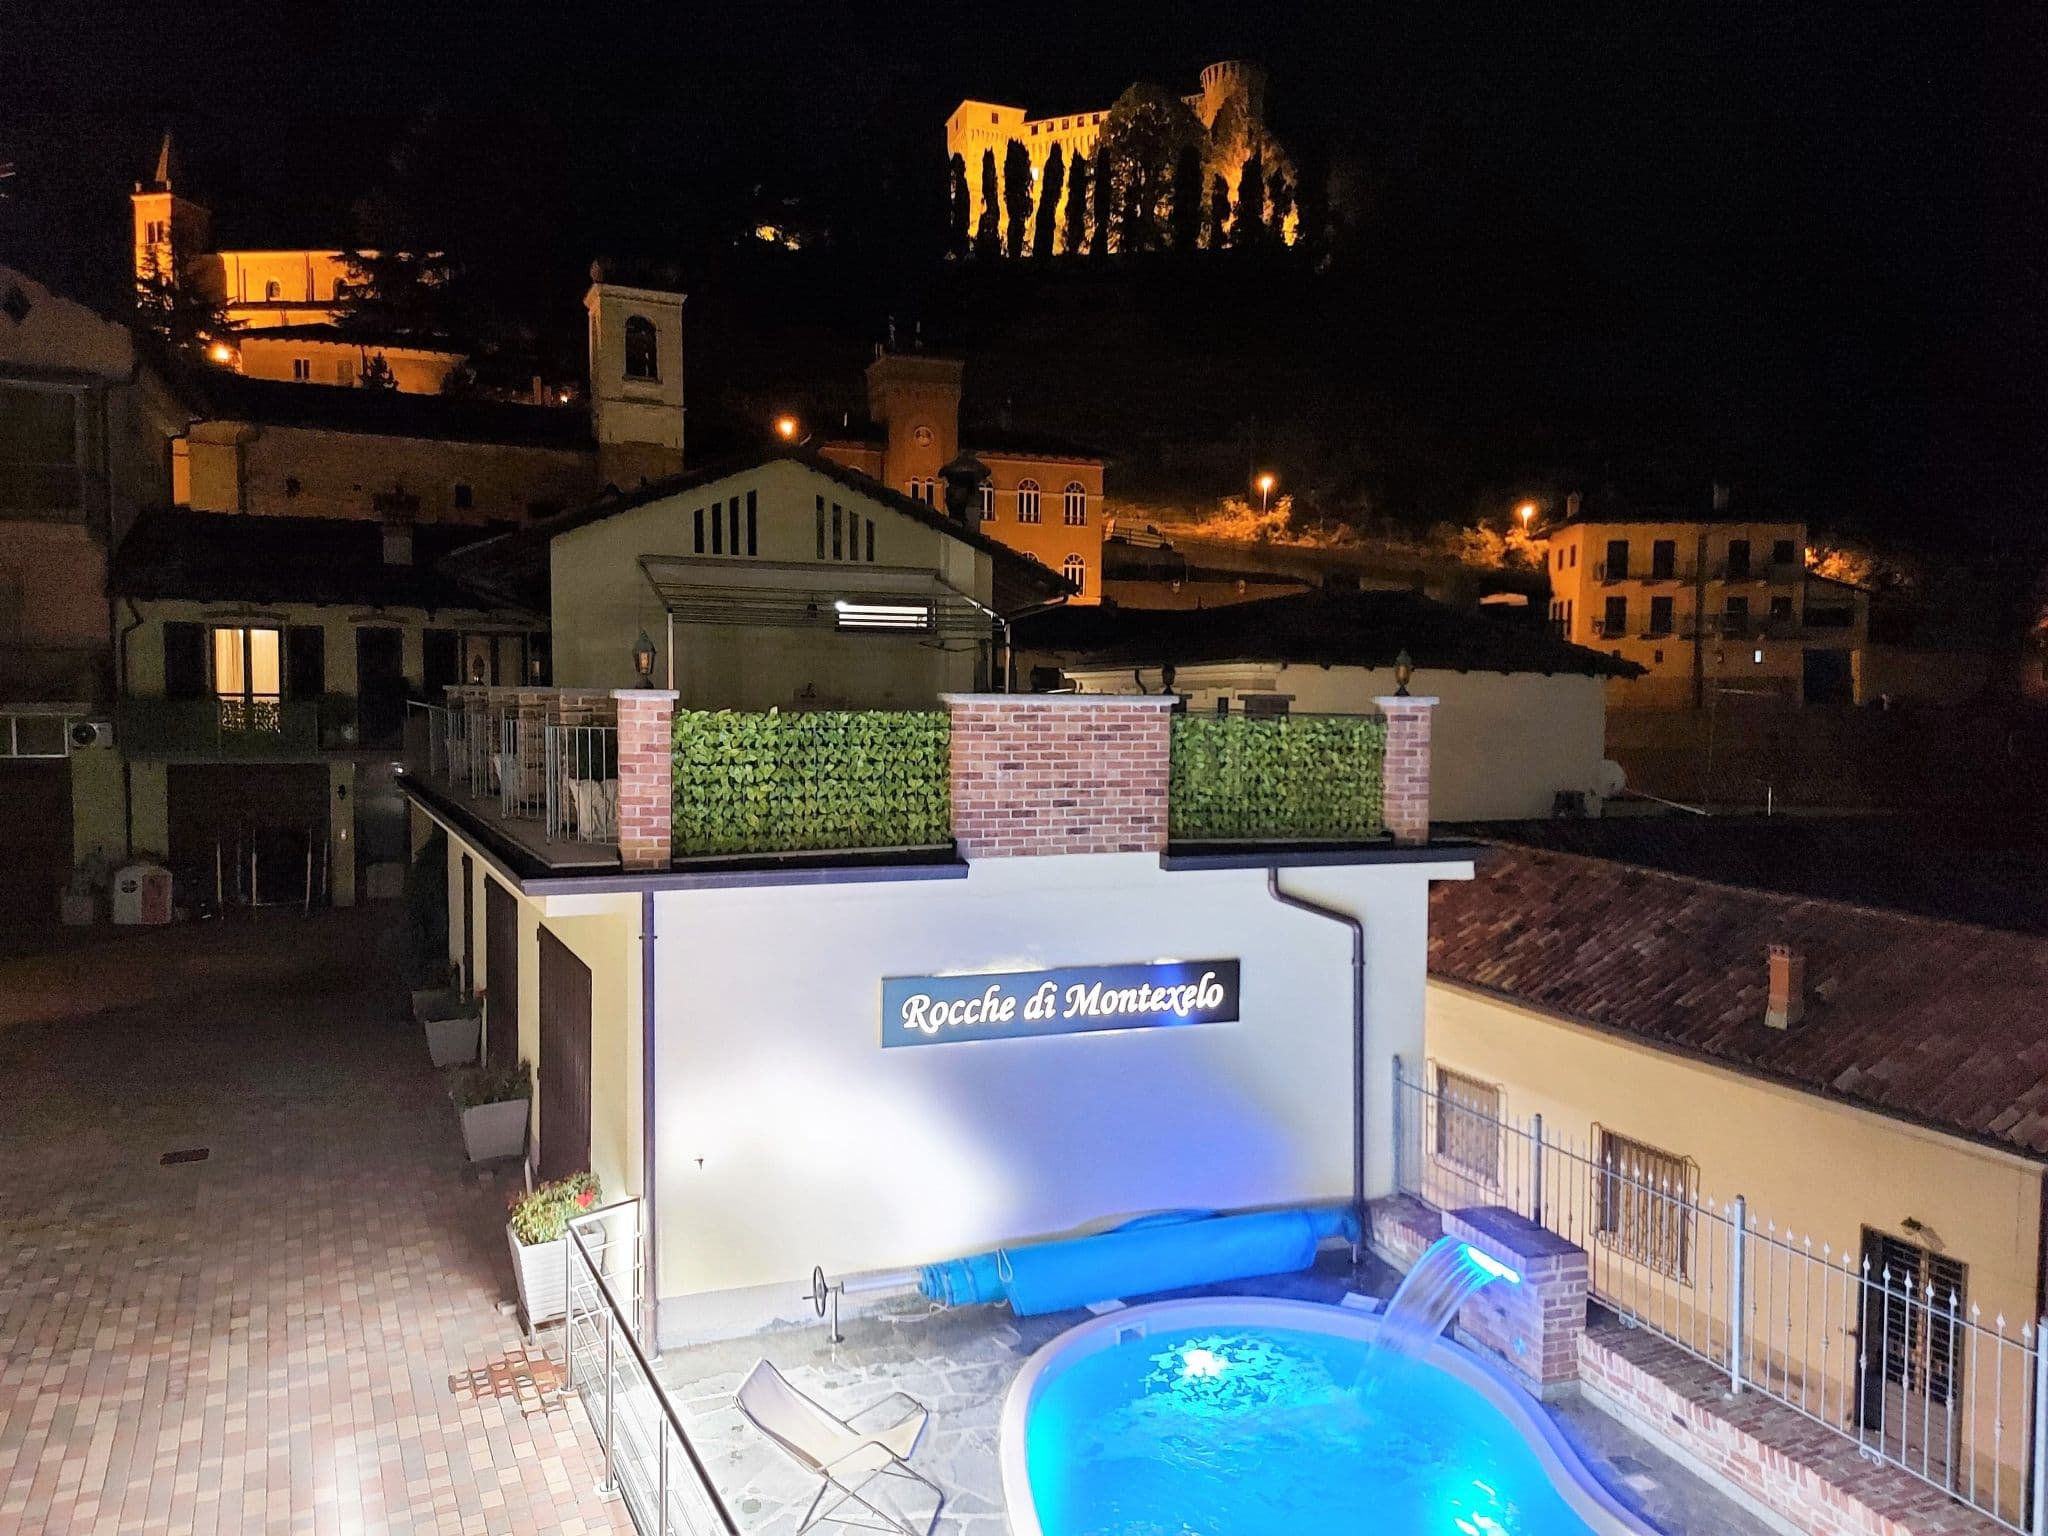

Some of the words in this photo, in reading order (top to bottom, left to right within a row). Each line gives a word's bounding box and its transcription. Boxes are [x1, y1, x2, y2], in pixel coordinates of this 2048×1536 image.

[902, 984, 1016, 1034] Rocche
[1023, 981, 1057, 1019] di
[1063, 971, 1224, 1018] Montexelo
